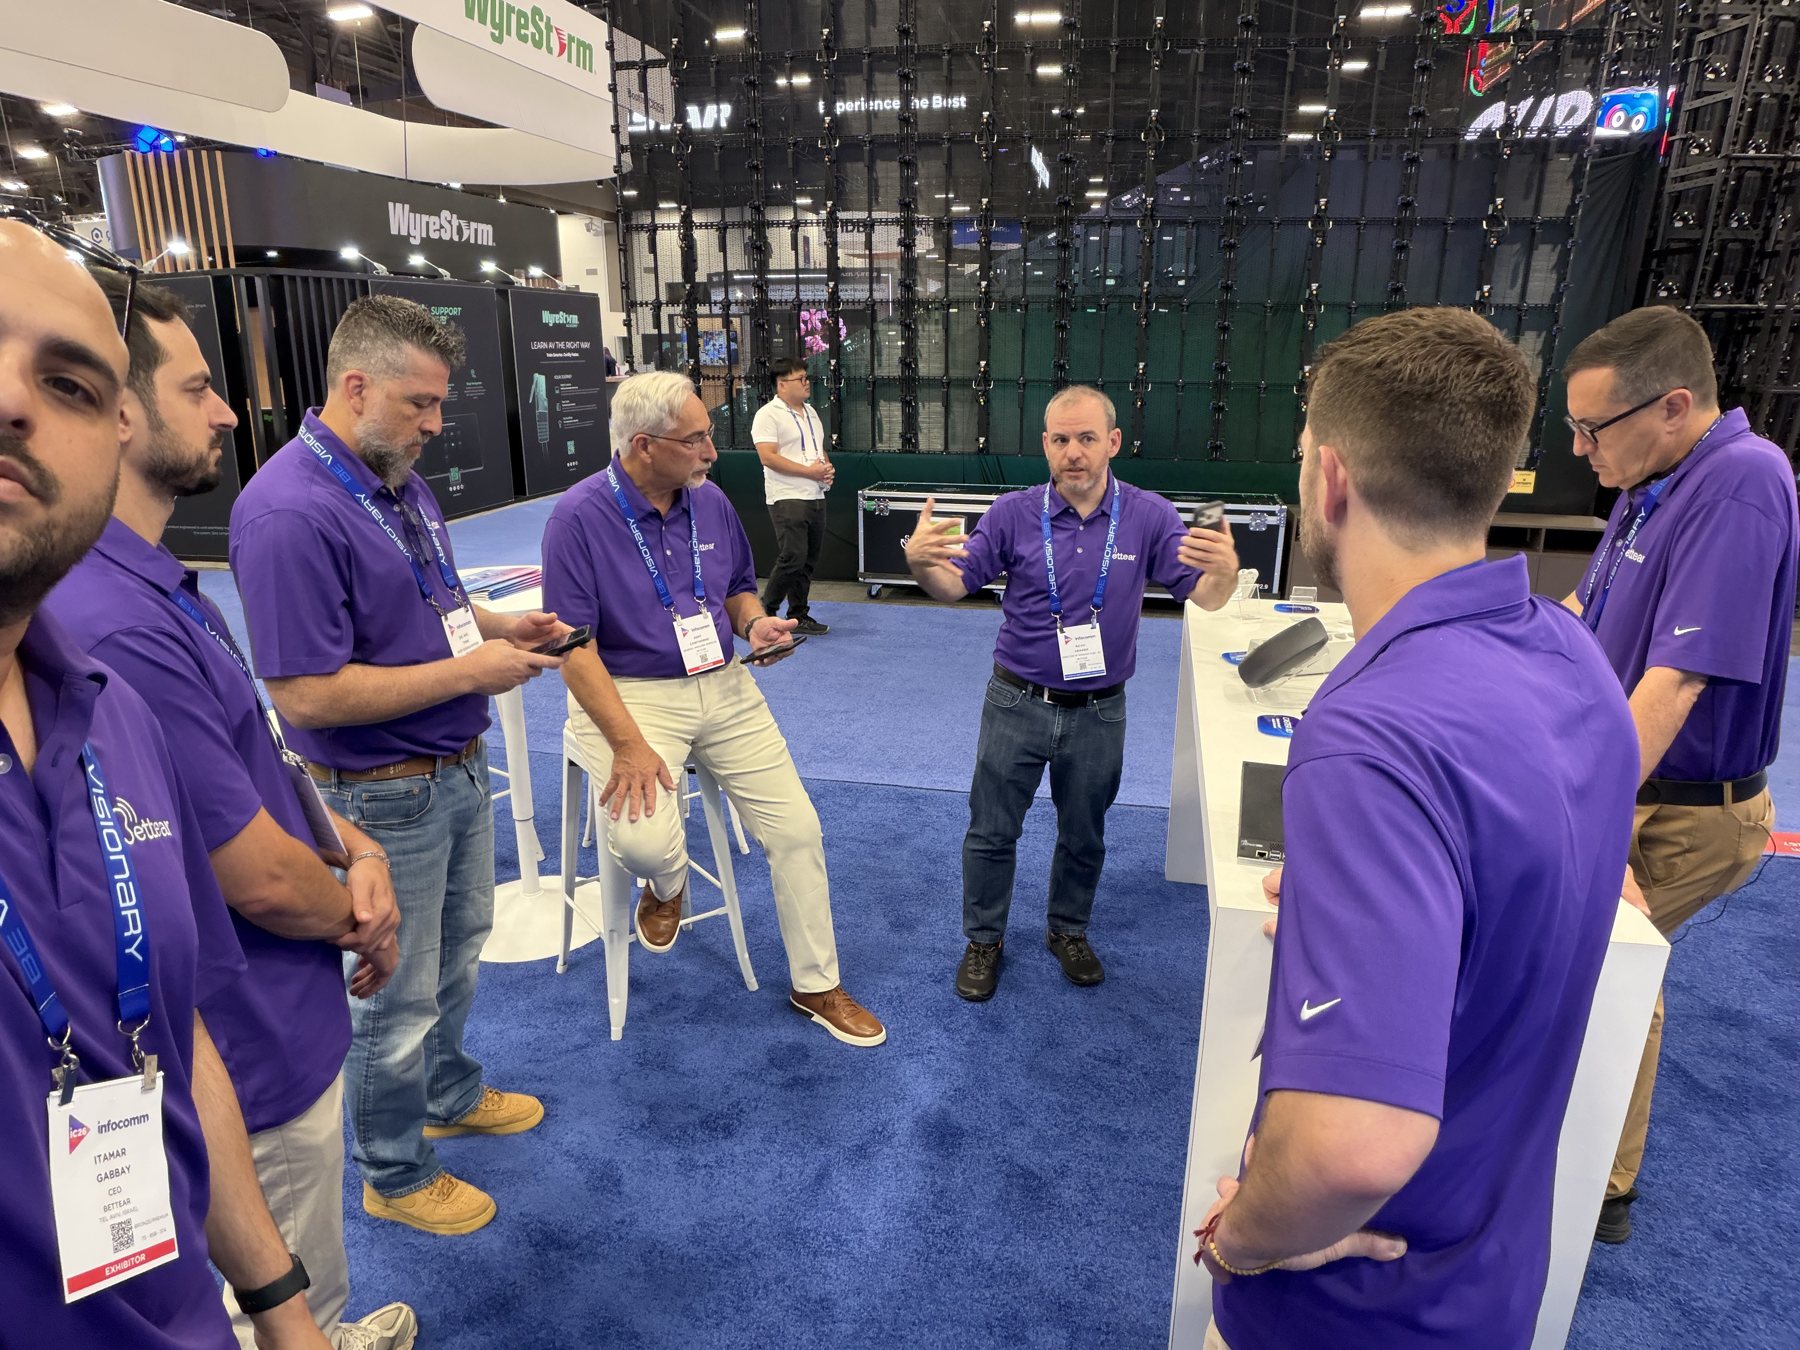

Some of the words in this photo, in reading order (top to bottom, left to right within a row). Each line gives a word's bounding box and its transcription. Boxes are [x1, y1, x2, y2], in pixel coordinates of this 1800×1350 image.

[819, 97, 900, 117] Eperience
[431, 306, 462, 316] SUPPORT
[531, 341, 548, 350] LEARN
[556, 341, 566, 349] THE
[6, 927, 42, 985] BE
[97, 1113, 149, 1134] infocomm
[94, 1147, 127, 1165] ITAMAR
[96, 1164, 131, 1183] GABBAY
[108, 1185, 122, 1197] CEO
[103, 1197, 131, 1212] BETTEAR
[105, 1253, 147, 1276] EXHIBITOR
